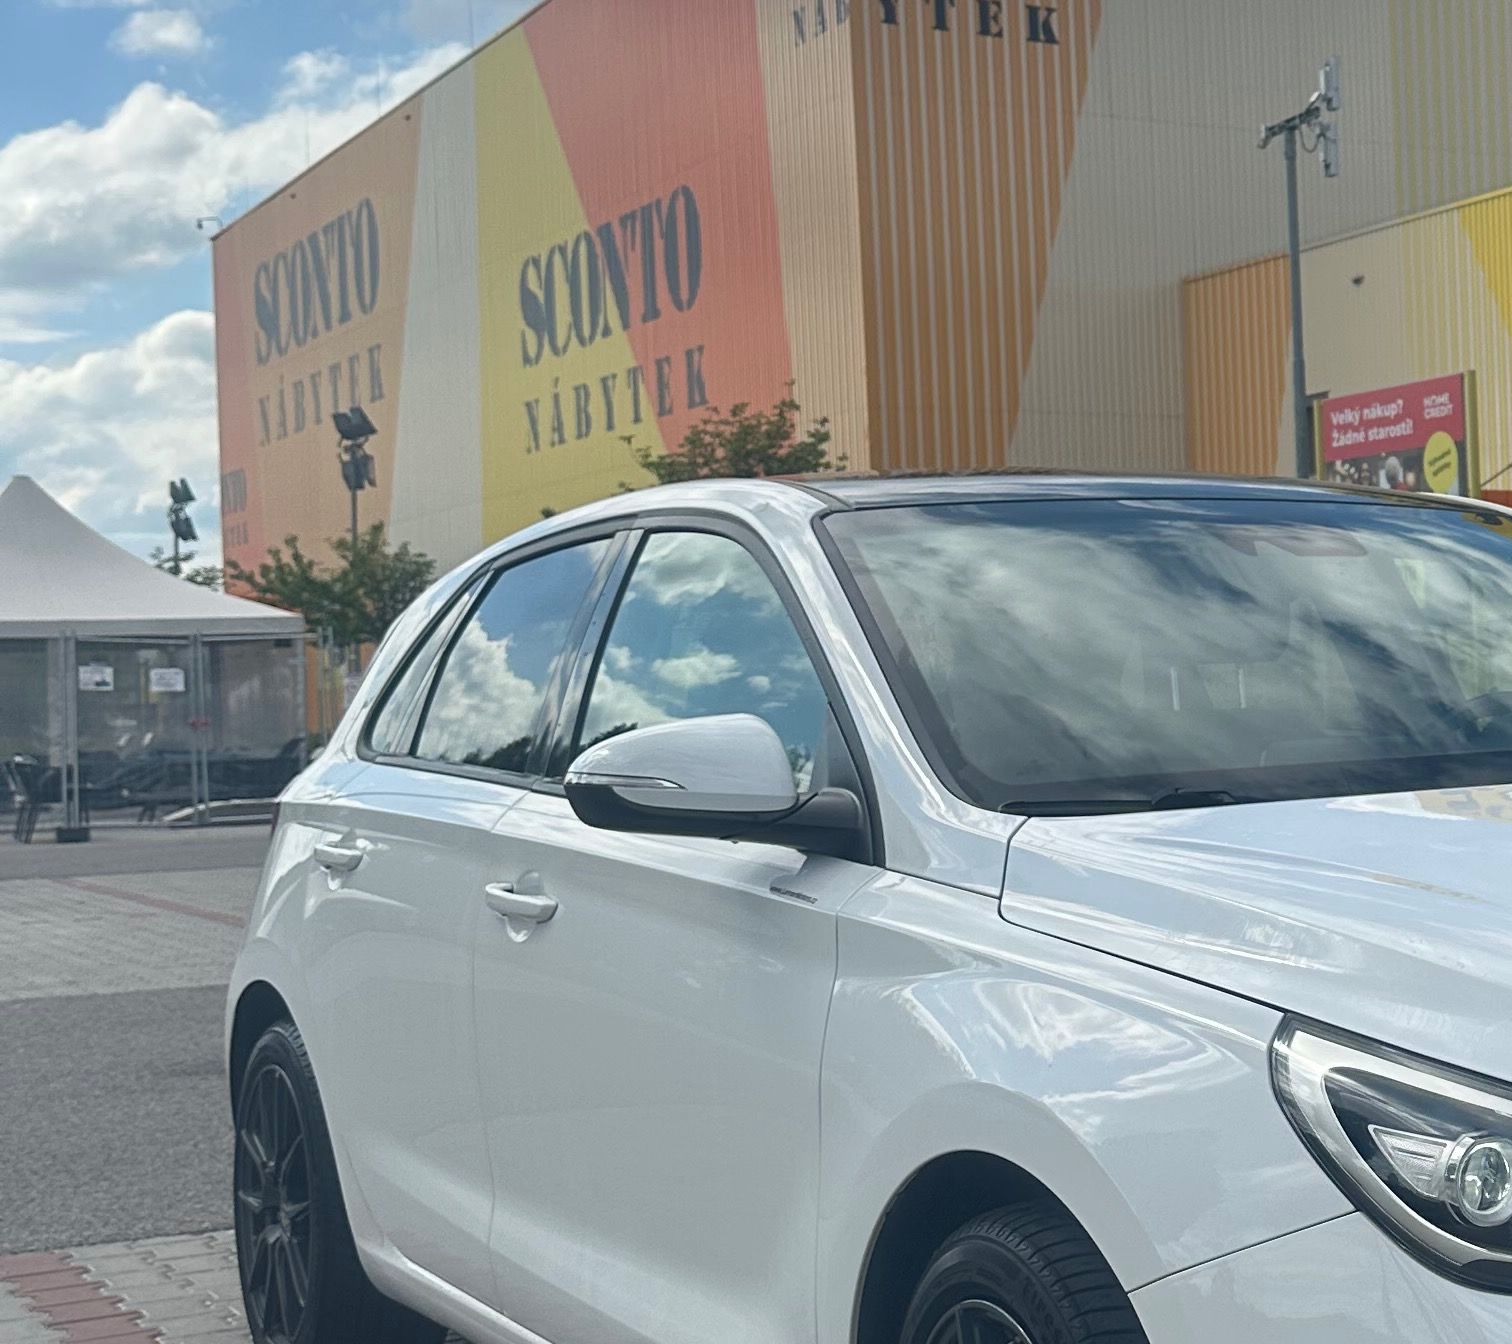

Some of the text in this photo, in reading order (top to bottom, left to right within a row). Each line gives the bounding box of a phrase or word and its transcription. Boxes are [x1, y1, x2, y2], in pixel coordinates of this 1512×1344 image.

[254, 197, 380, 366] SCONTO
[519, 184, 703, 368] SCONTO
[524, 345, 709, 454] NÁBYTEK
[1330, 399, 1404, 426] Velký nákup?
[1332, 418, 1414, 447] Žádné starosti!
